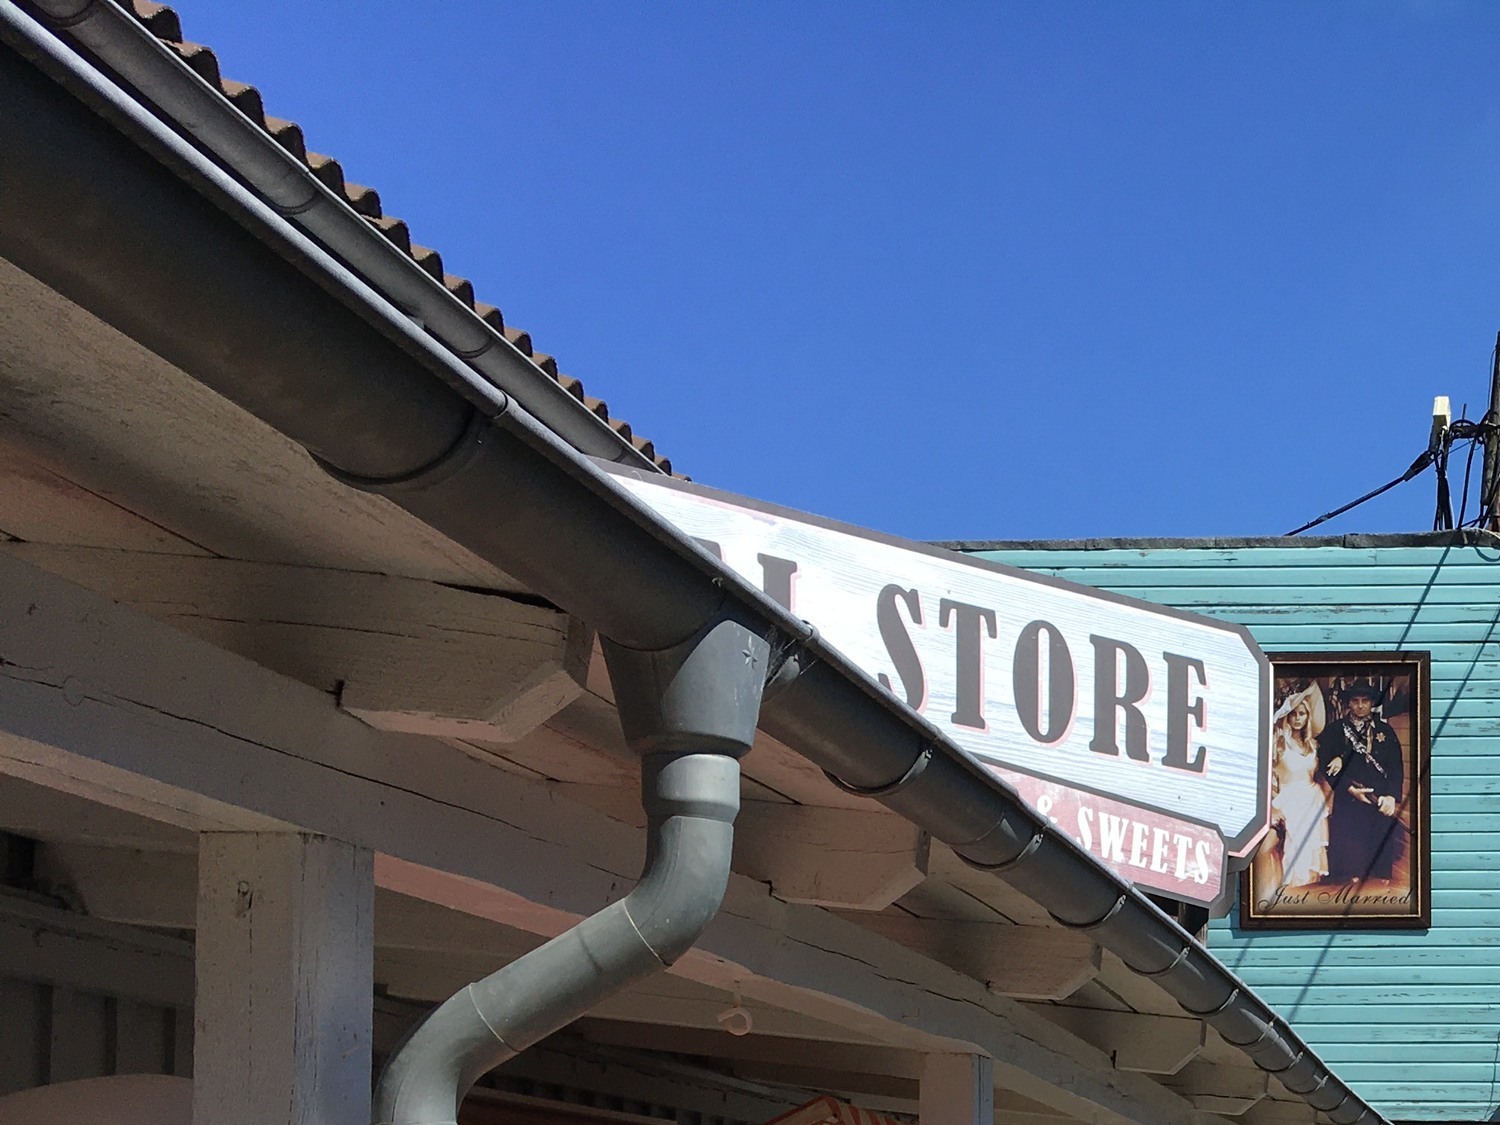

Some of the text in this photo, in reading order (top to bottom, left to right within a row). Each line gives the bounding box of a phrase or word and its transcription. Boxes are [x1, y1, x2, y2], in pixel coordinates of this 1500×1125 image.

[876, 583, 1209, 774] STORE
[1076, 806, 1211, 885] SWEETS
[1258, 881, 1414, 912] Just Married
